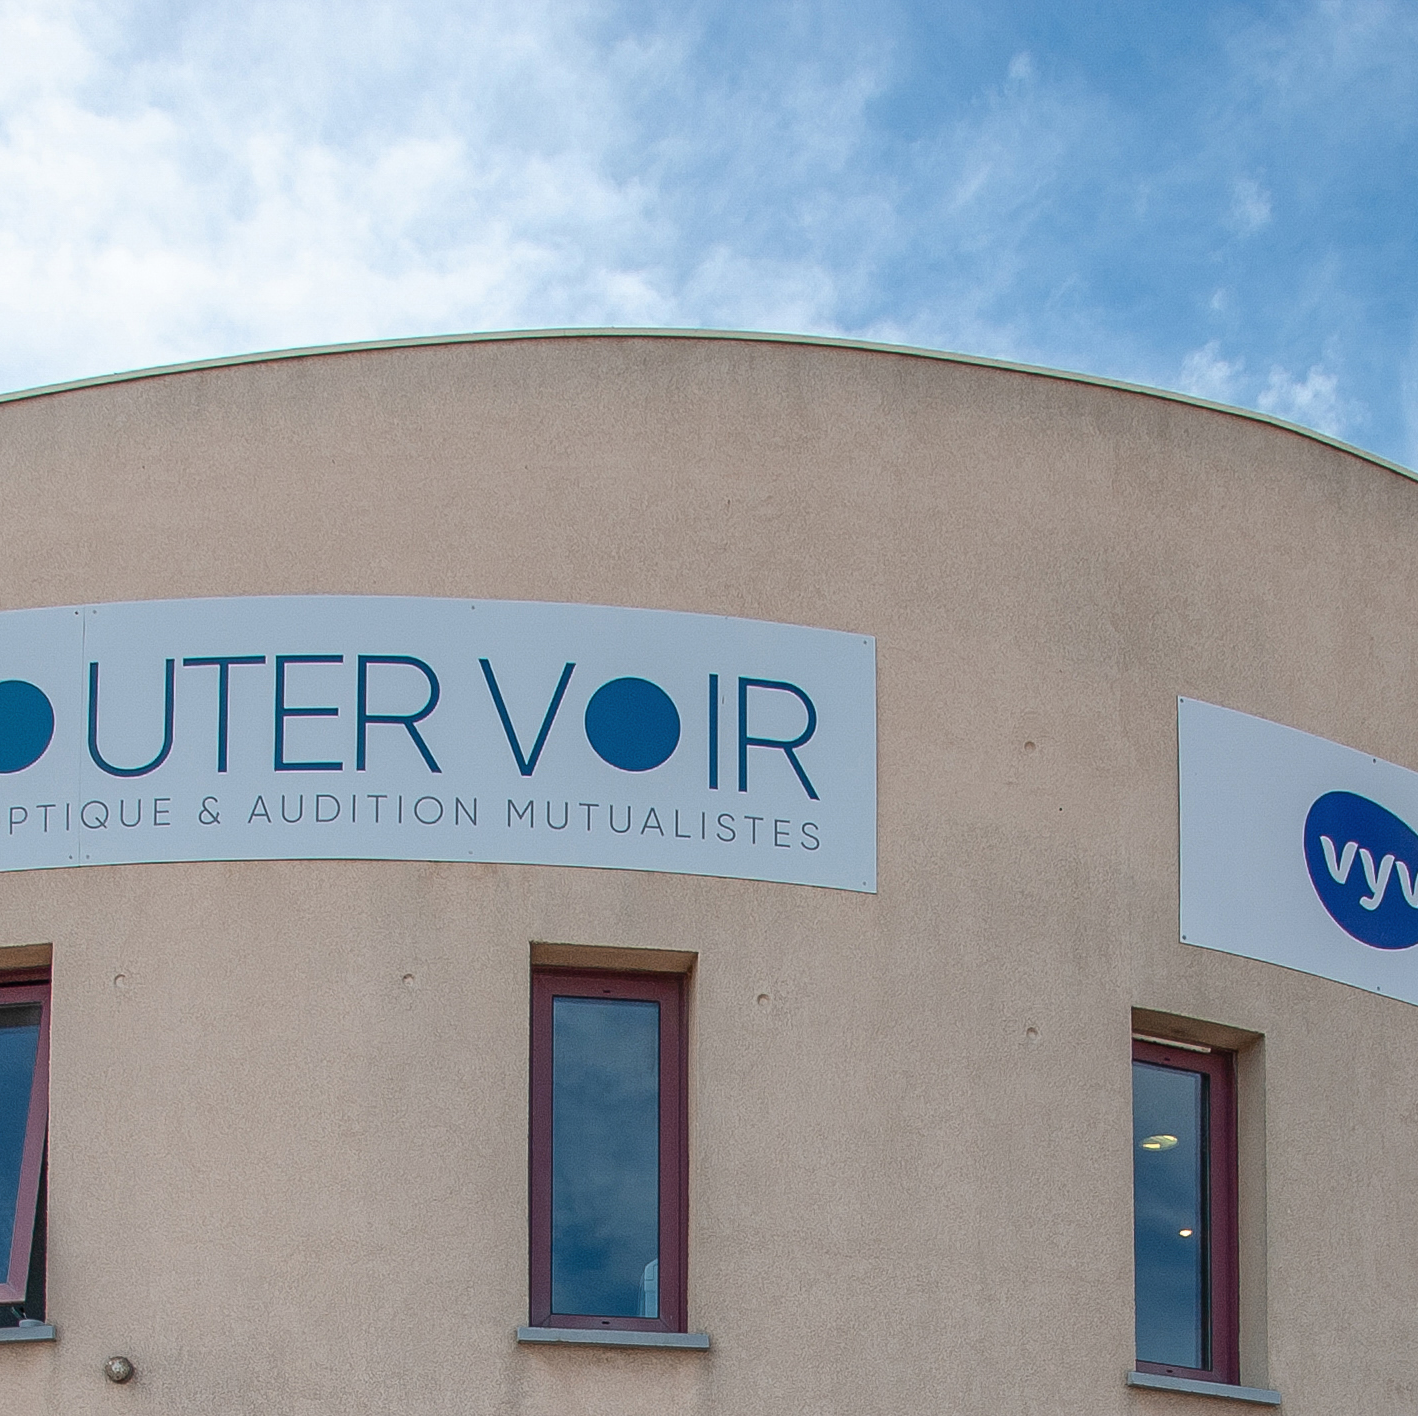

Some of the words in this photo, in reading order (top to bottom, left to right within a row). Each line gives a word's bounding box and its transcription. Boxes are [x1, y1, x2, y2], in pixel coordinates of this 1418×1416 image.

[478, 658, 820, 801] VOIR
[198, 796, 222, 826] &
[248, 794, 478, 827] AUDITION
[507, 798, 821, 851] MUTUALISTES
